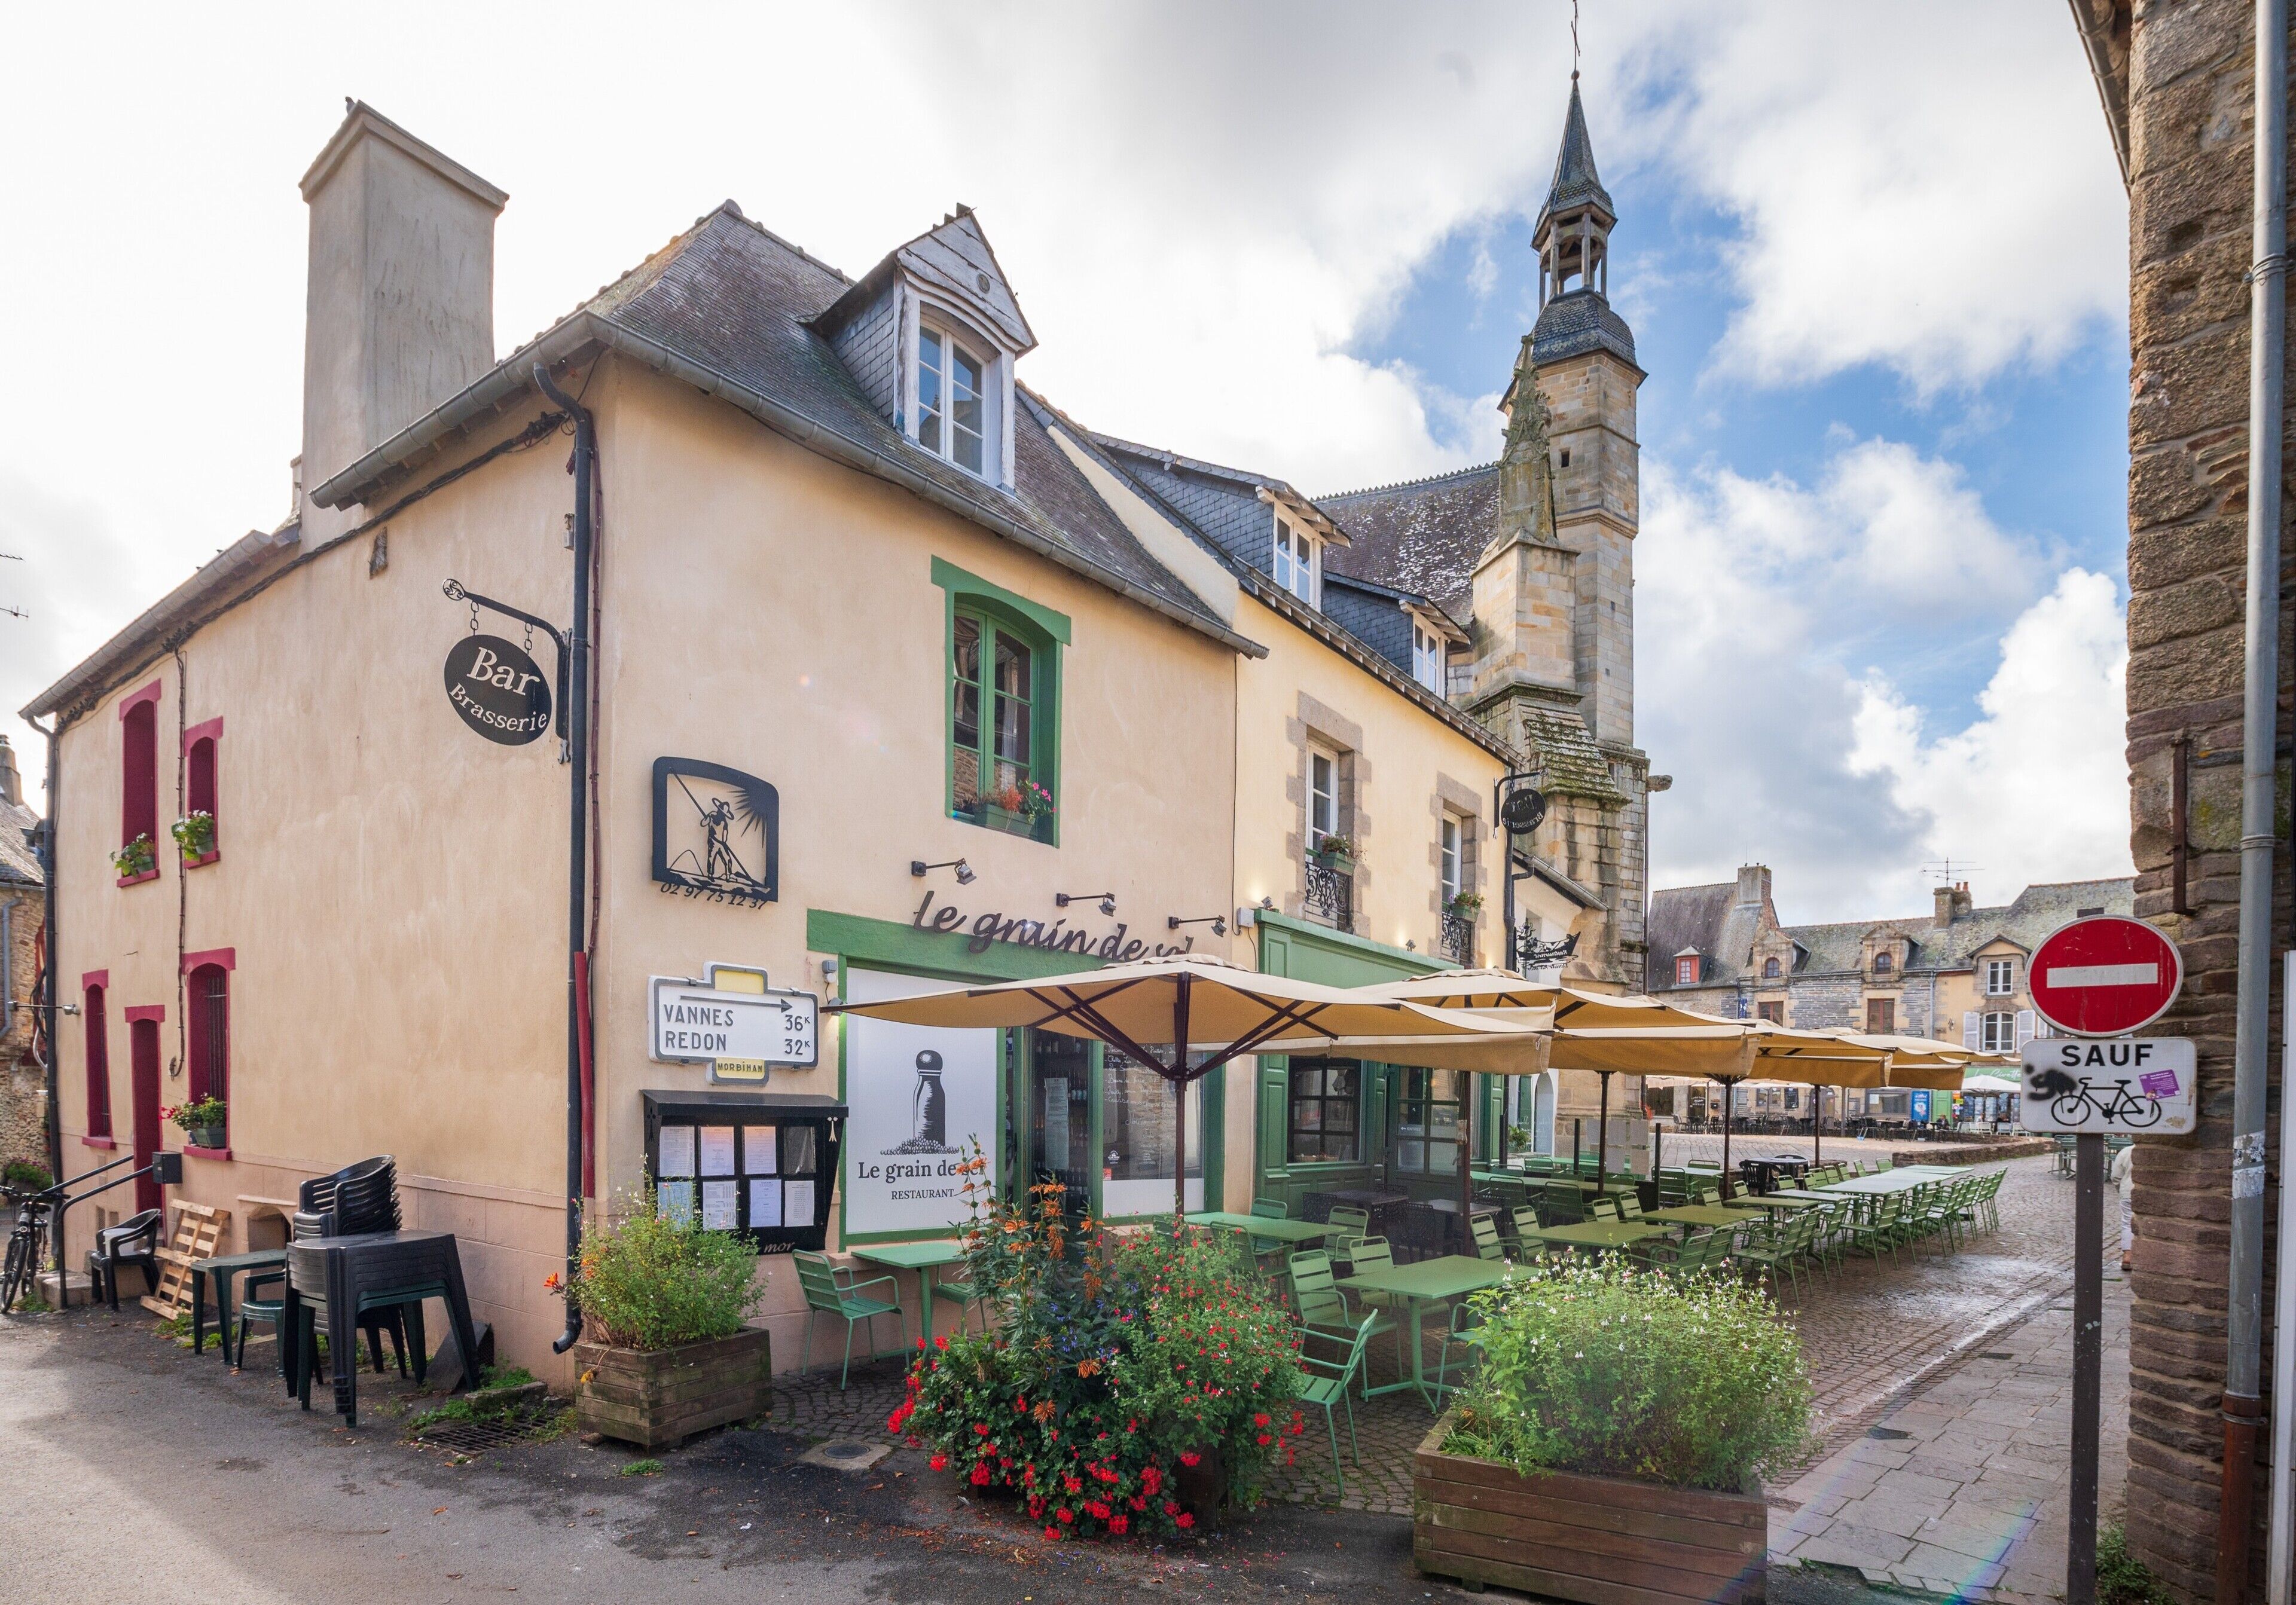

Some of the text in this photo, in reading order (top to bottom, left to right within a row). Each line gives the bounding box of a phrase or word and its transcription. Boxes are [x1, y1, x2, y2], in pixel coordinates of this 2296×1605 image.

[467, 646, 540, 696] Bar
[449, 682, 546, 732] Brasserie
[660, 882, 768, 910] 02 97 75 12 37
[969, 913, 1097, 955] grain
[1099, 923, 1149, 962] de
[664, 1004, 734, 1027] VANNES
[665, 1031, 727, 1051] REDON
[2061, 1044, 2153, 1067] SAUF
[858, 1161, 880, 1179] Le
[886, 1160, 932, 1184] grain
[937, 1160, 957, 1177] de
[891, 1188, 954, 1200] RESTAURANT
[764, 1242, 795, 1254] mor
